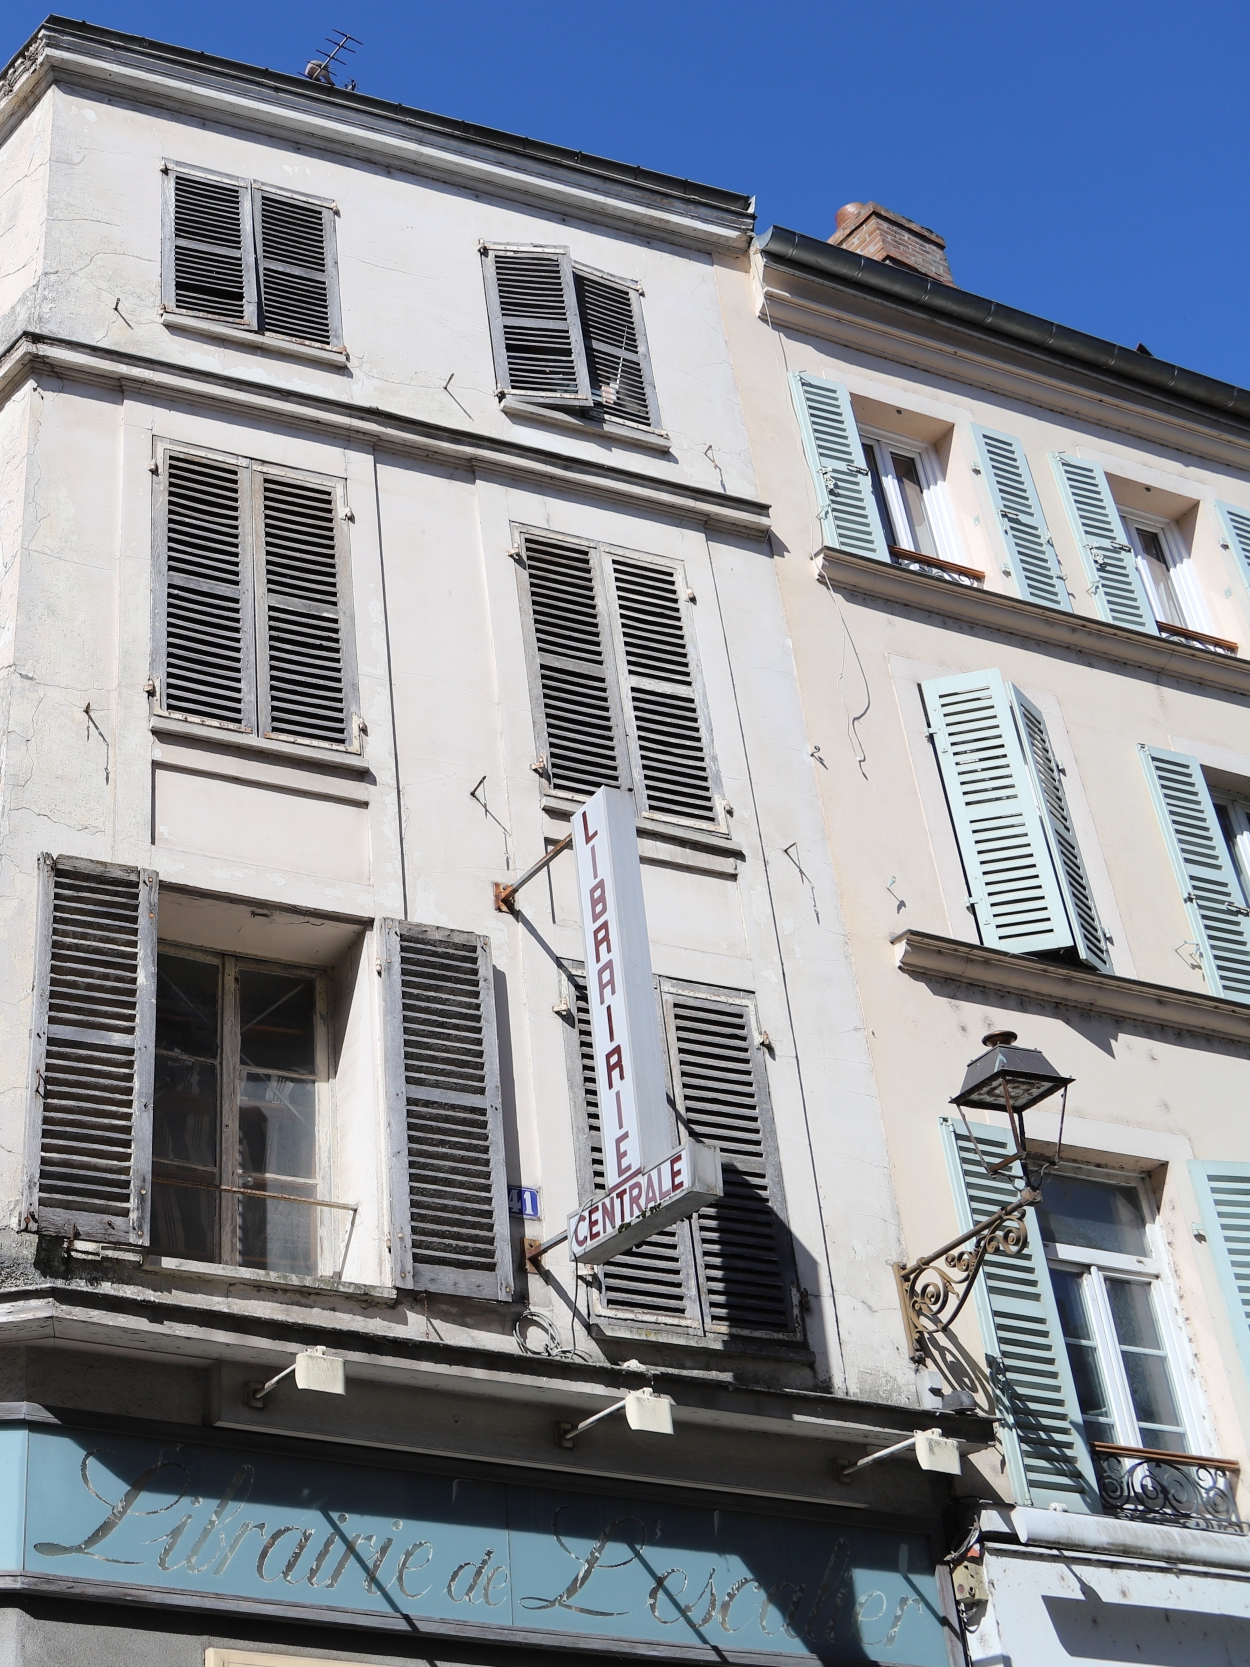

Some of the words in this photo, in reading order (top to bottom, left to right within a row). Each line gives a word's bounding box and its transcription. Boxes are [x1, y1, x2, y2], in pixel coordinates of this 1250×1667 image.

[581, 810, 633, 1178] LIBRAIRIE
[508, 1190, 534, 1215] 41
[574, 1153, 685, 1248] CENTRALE
[33, 1448, 433, 1599] Librairie
[445, 1548, 509, 1606] de
